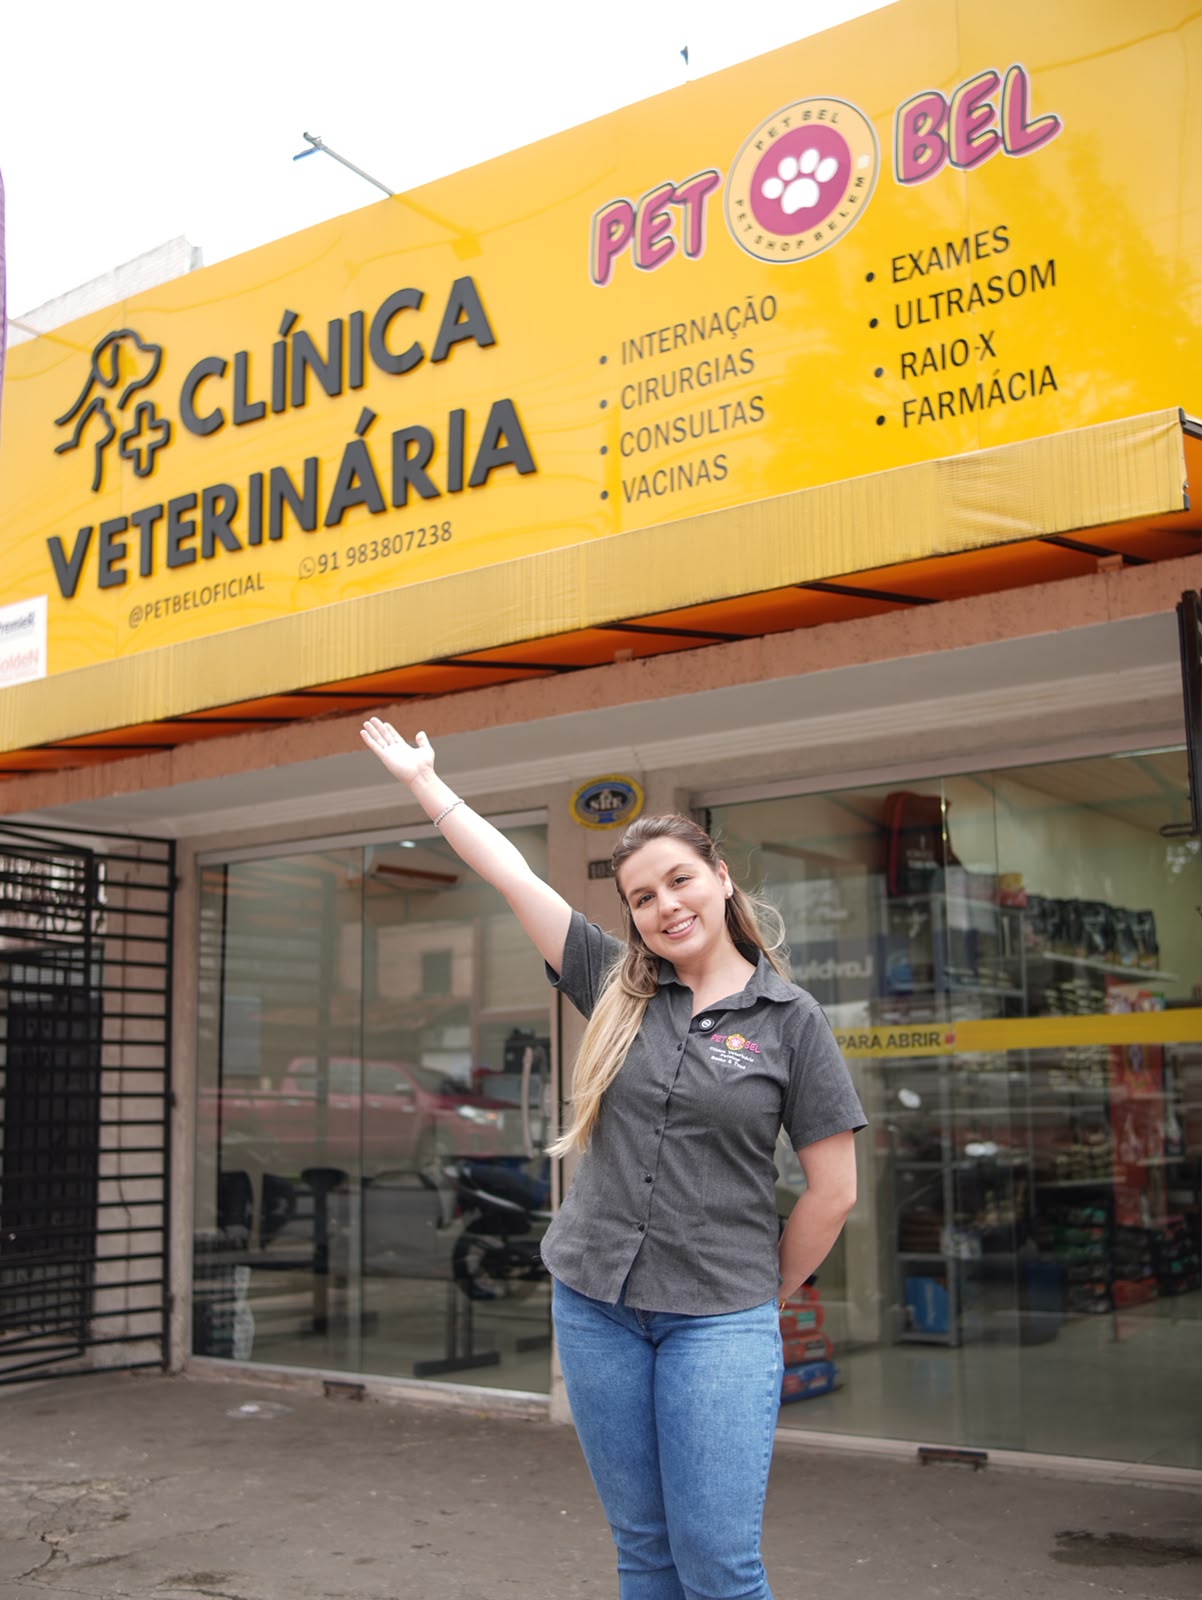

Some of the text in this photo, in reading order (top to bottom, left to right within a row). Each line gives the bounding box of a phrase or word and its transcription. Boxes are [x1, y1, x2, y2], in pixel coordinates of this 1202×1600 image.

[590, 64, 1062, 286] PET BEL
[891, 226, 1010, 284] EXAMES
[894, 259, 1057, 329] ULTRASOM
[179, 275, 496, 437] CLÍNICA
[621, 295, 778, 366] INTERNAÇÃO
[900, 331, 998, 380] RAIO-X
[620, 348, 755, 411] CIRURGIAS
[902, 364, 1058, 428] FARMÁCIA
[619, 396, 765, 458] CONSULTAS
[46, 398, 537, 599] VETERINÁRIA
[621, 453, 729, 504] VACINAS
[318, 521, 453, 575] 91 983807238
[128, 573, 264, 629] @PETBELOFICIAL
[710, 1033, 761, 1054] PET BEL
[837, 1032, 940, 1049] PARA ABRIR
